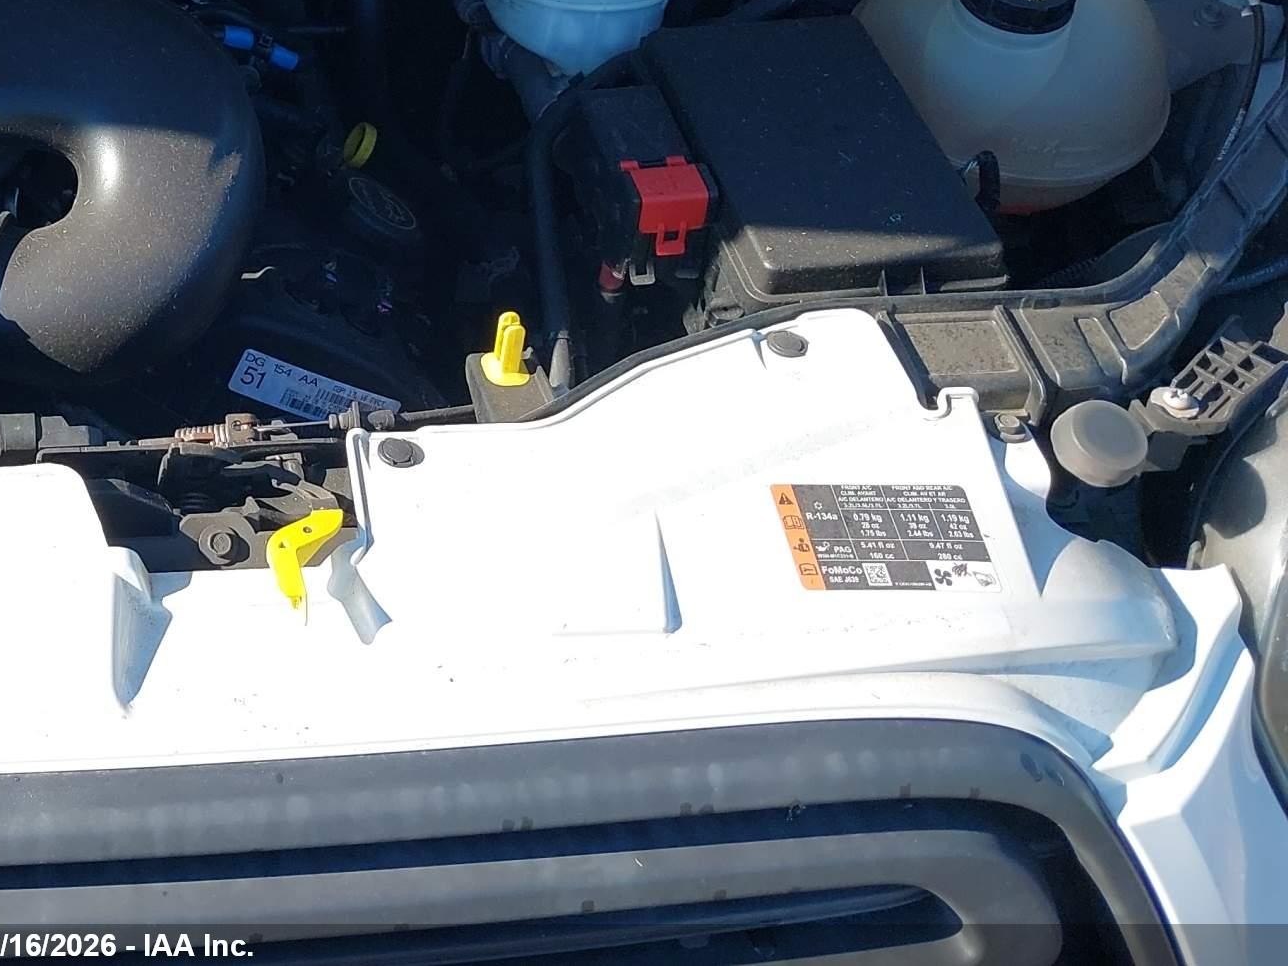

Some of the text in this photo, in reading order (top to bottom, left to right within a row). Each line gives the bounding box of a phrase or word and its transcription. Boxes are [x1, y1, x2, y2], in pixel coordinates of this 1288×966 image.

[245, 352, 265, 367] DG
[273, 363, 292, 377] 154
[298, 374, 318, 387] AA
[240, 367, 266, 389] 51
[806, 512, 839, 521] R-134a
[853, 513, 883, 524] 0.79 kg
[900, 513, 929, 524] 1.11 kg
[941, 514, 969, 524] 1.19 kg
[821, 565, 863, 575] FoMoCo
[829, 575, 843, 583] SAE
